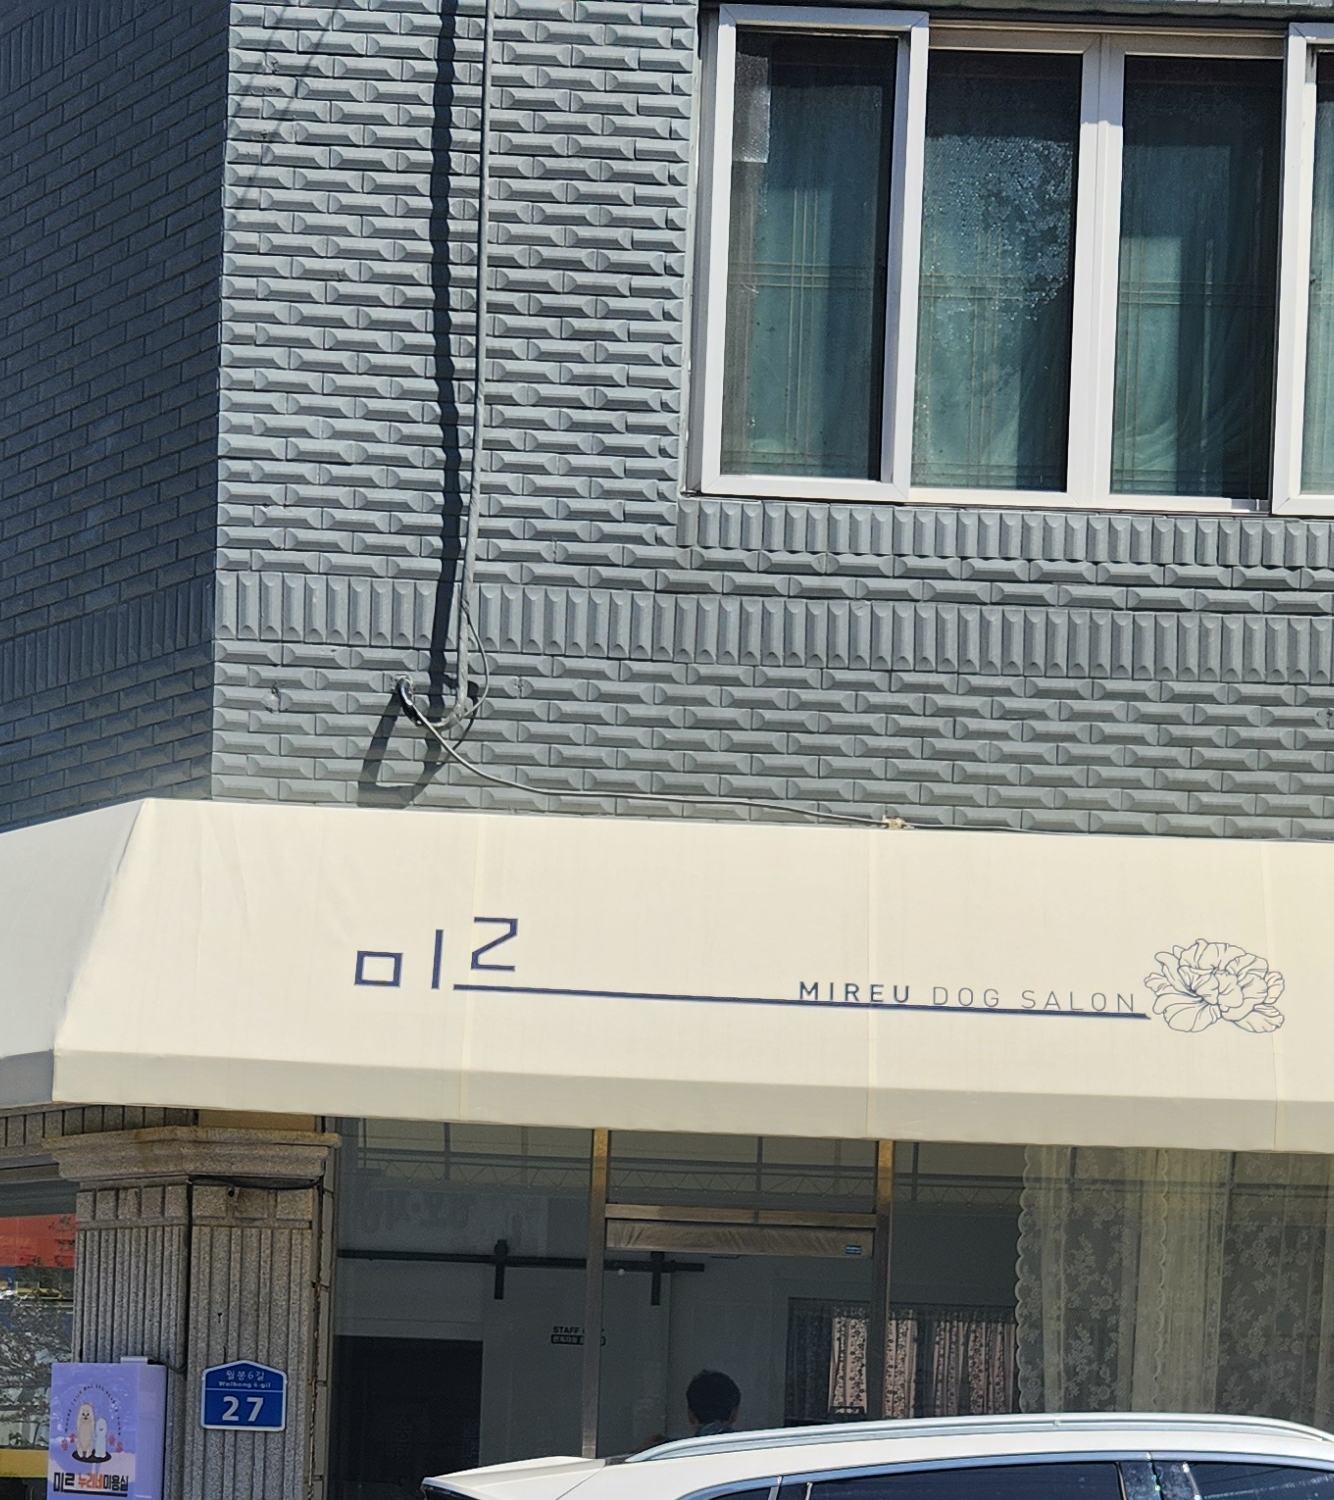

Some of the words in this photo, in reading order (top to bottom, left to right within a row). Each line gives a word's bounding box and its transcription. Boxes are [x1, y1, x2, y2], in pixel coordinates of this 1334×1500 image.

[798, 979, 912, 1004] MIREU
[932, 985, 1002, 1010] DOG
[1019, 988, 1138, 1015] SALON
[552, 1325, 581, 1334] STAFF
[221, 1395, 265, 1423] 27
